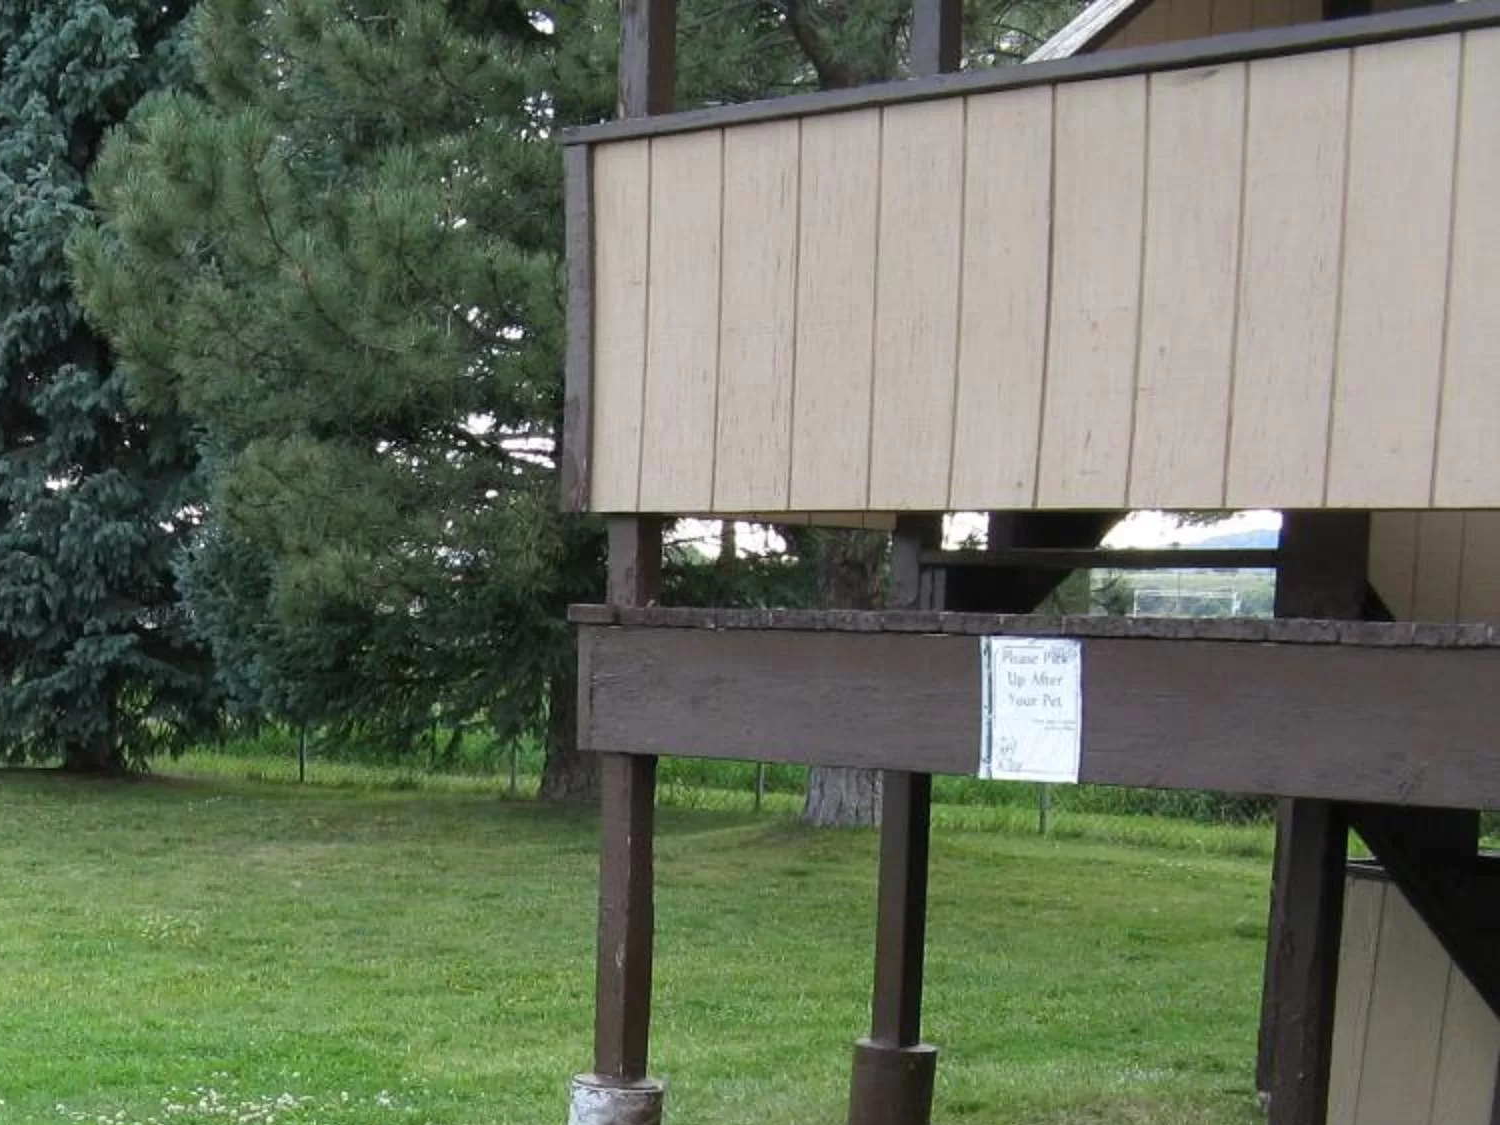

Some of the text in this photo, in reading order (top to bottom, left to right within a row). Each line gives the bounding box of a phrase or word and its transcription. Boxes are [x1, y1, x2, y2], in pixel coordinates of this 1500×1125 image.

[1002, 649, 1039, 664] Please
[1007, 671, 1064, 688] Up After
[1007, 692, 1063, 708] Your Pet
